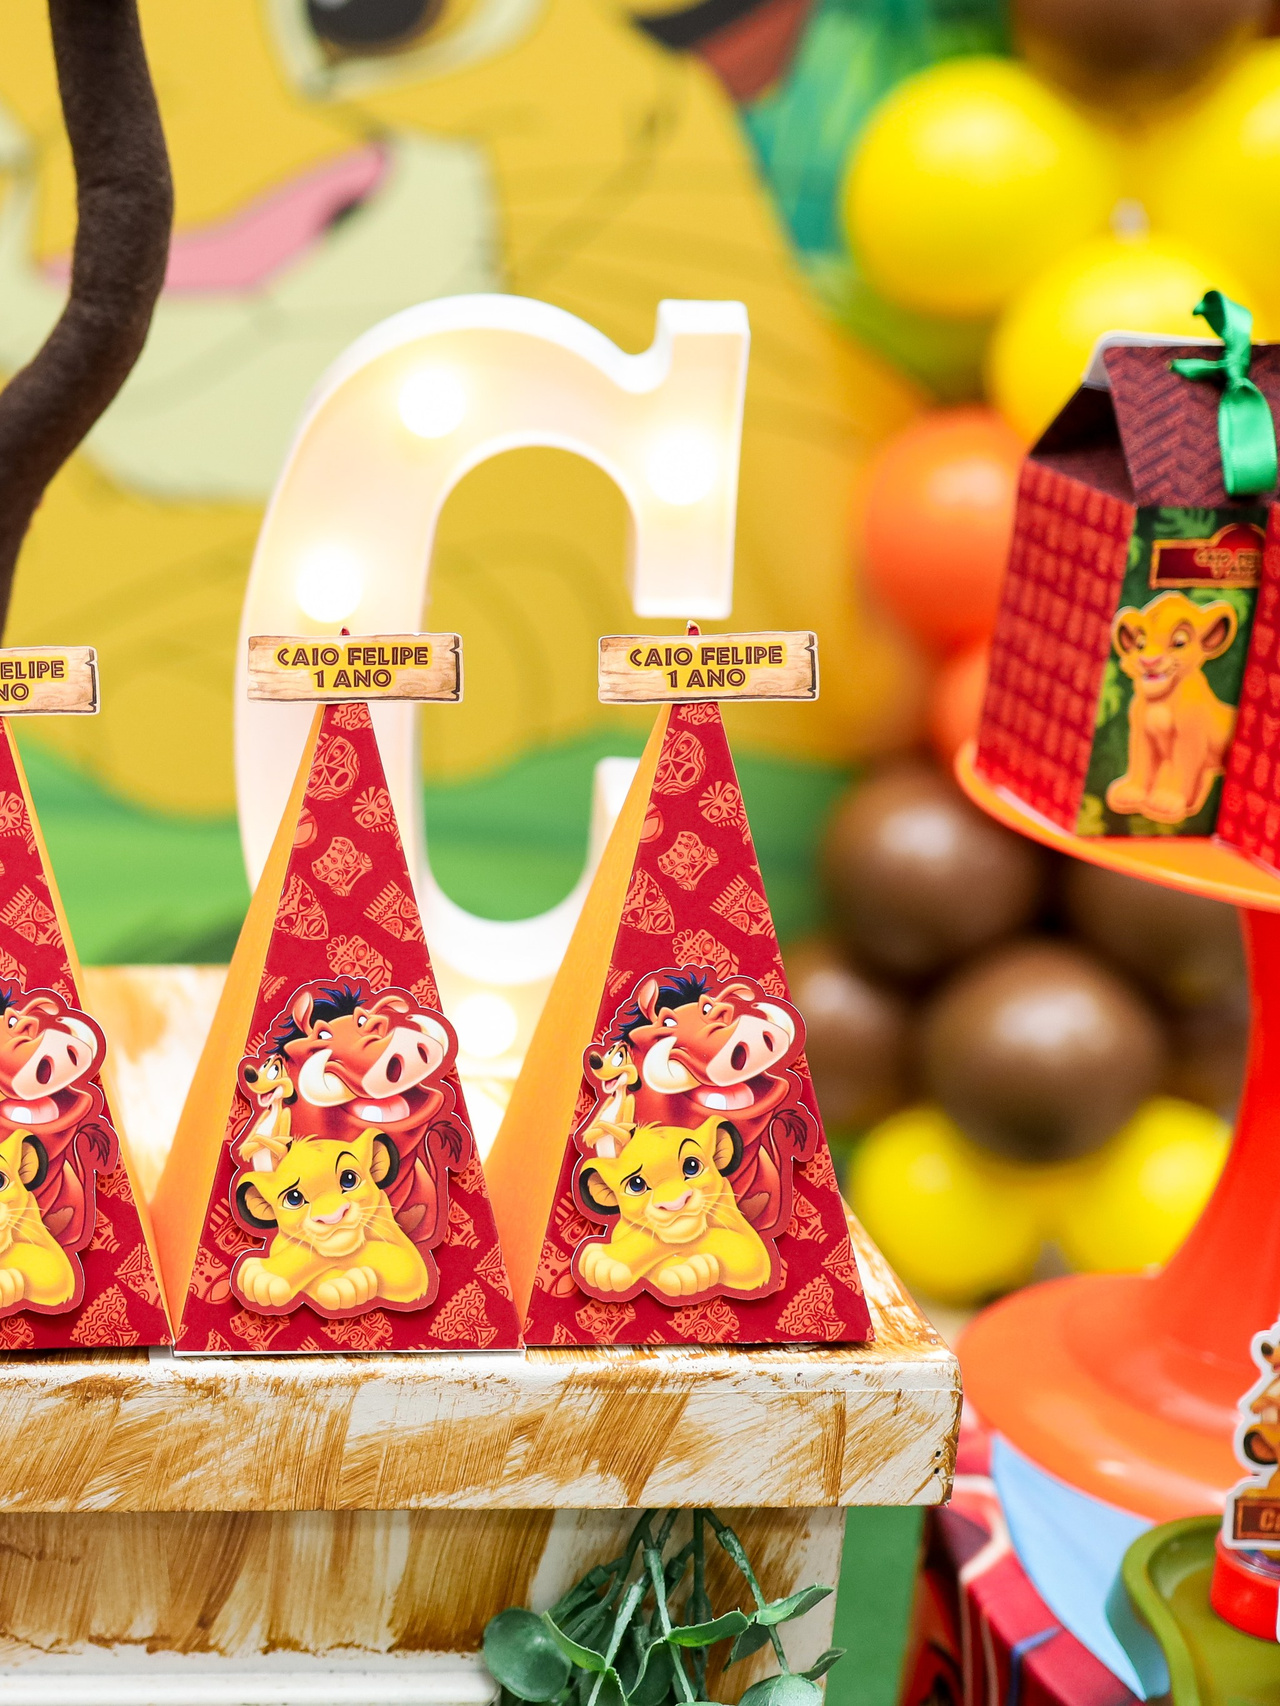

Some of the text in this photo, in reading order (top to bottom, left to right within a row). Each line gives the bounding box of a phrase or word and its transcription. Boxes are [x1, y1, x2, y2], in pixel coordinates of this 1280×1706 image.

[277, 646, 429, 666] CAIO FELIPE
[630, 645, 783, 667] CAIO FELIPE
[313, 669, 391, 688] 1 ANO
[666, 668, 746, 688] 1 ANO
